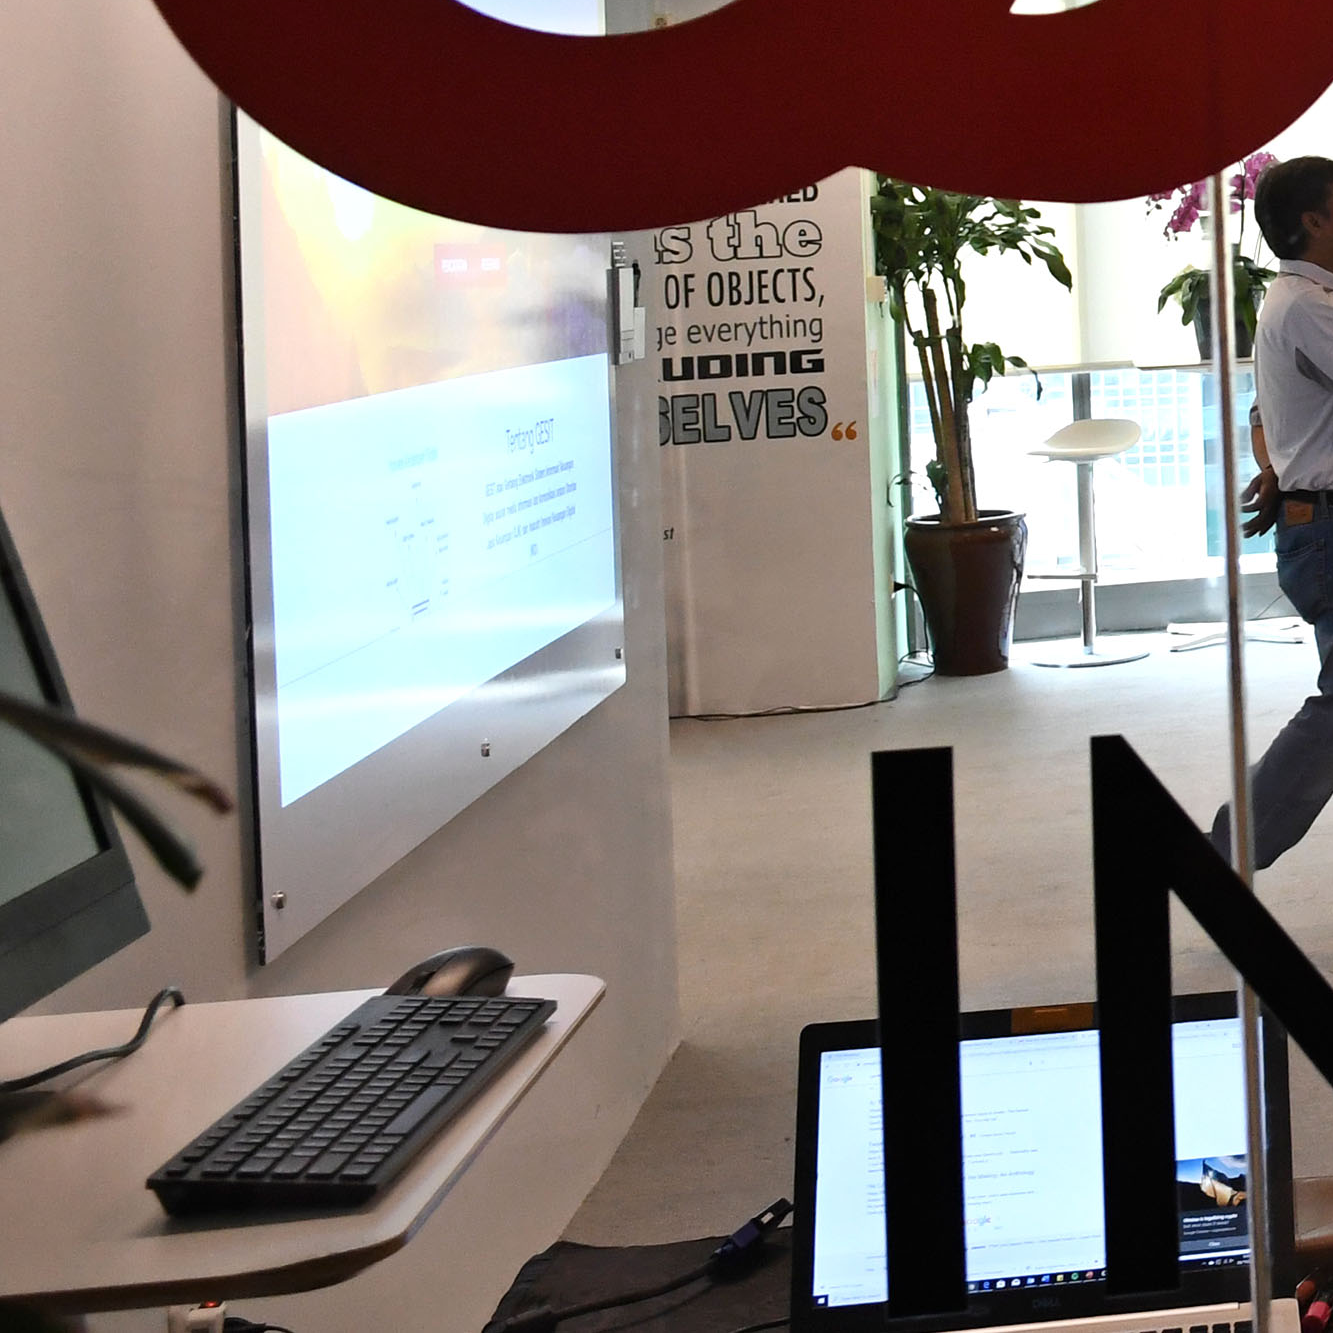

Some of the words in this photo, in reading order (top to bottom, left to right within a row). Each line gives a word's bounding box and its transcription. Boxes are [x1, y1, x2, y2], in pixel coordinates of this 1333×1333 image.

[706, 209, 823, 262] the
[664, 273, 696, 310] OF
[706, 266, 825, 309] OBJECTS,
[686, 313, 824, 348] everything
